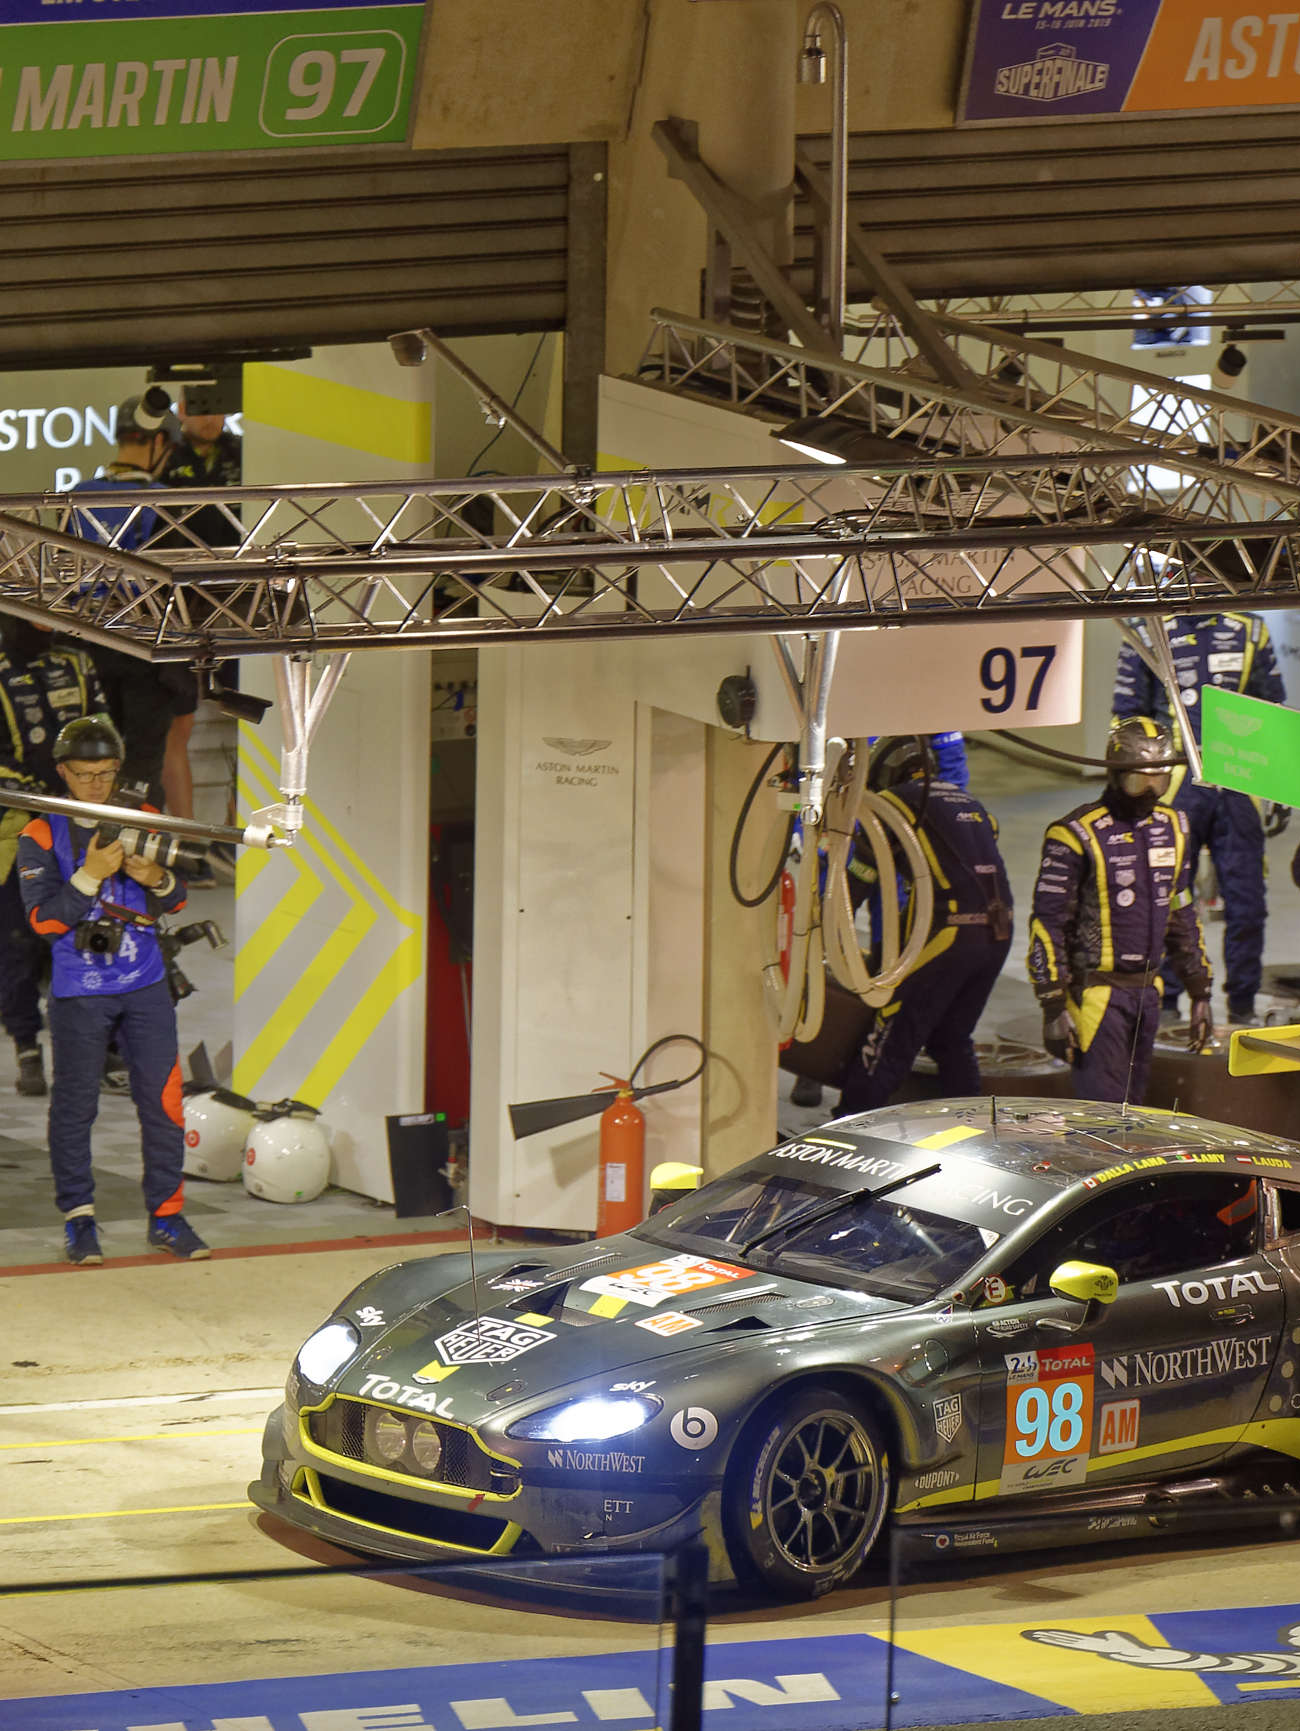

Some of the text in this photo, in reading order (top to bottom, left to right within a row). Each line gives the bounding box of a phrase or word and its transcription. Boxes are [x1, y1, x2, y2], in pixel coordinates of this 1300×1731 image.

[1001, 0, 1117, 19] LE MANS
[11, 47, 387, 132] MARTIN 97
[998, 58, 1107, 99] SUPERFINALE
[897, 576, 972, 596] ACING
[979, 645, 1057, 714] 97
[1097, 1155, 1168, 1184] DALLA LANA
[1193, 1152, 1227, 1164] LAMY
[1252, 1155, 1293, 1170] LAUDA
[768, 1143, 838, 1167] ASTON
[970, 1186, 1034, 1218] ING
[618, 1262, 740, 1293] 98 TOTAL
[1151, 1270, 1281, 1309] TOTAL
[355, 1305, 386, 1328] sky
[644, 1314, 695, 1334] AM
[442, 1331, 518, 1361] HEUER
[472, 1319, 539, 1347] TAG
[1041, 1356, 1091, 1372] TOTAL
[1134, 1335, 1272, 1387] NORTHWEST
[358, 1374, 456, 1420] TOTAL
[609, 1380, 657, 1394] sky
[935, 1400, 959, 1417] TAG
[1015, 1382, 1084, 1457] 98
[937, 1414, 961, 1438] HEUER
[1102, 1404, 1137, 1447] AM
[566, 1449, 646, 1474] NORTHWEST
[1022, 1457, 1078, 1480] WEC
[920, 1471, 956, 1489] DUPONT
[120, 1672, 842, 1731] HELIN
